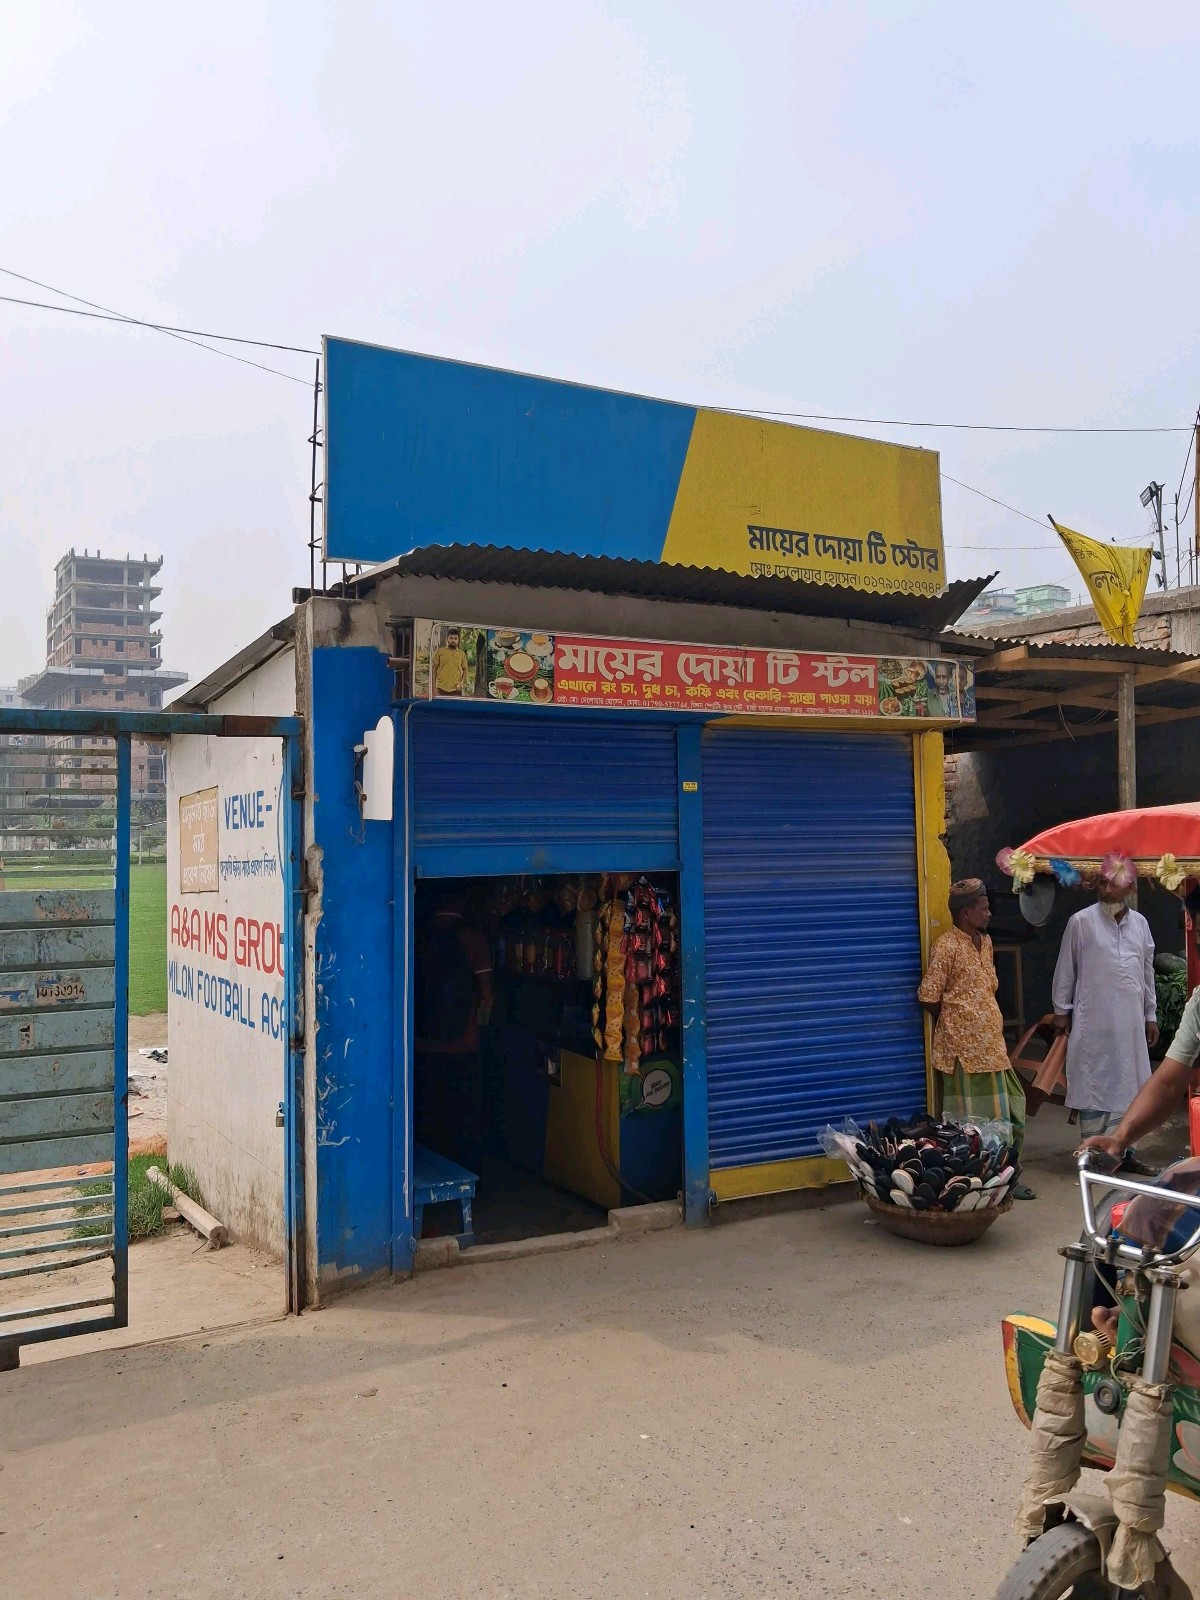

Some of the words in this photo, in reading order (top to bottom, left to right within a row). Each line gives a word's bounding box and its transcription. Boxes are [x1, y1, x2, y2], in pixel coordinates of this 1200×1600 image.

[747, 525, 809, 558] মায়ের
[814, 534, 863, 565] দোয়া
[867, 530, 887, 565] টি
[891, 539, 939, 573] স্টোর
[750, 561, 771, 576] মোঃ
[774, 565, 821, 582] দেলোয়ার
[557, 644, 663, 682] মায়ের
[677, 652, 755, 686] দোয়া
[766, 652, 800, 685] টি
[811, 656, 875, 688] স্টল
[557, 680, 596, 692] এখানে
[601, 681, 616, 694] রং
[621, 682, 637, 696] চা,
[642, 684, 661, 699] দুধ
[665, 685, 681, 698] চা,
[685, 683, 711, 698] কফি
[716, 688, 739, 700] এবং
[820, 693, 850, 704] পাওয়া
[204, 910, 228, 960] MS
[168, 959, 194, 1001] MILON
[197, 970, 256, 1028] FOOTBALL
